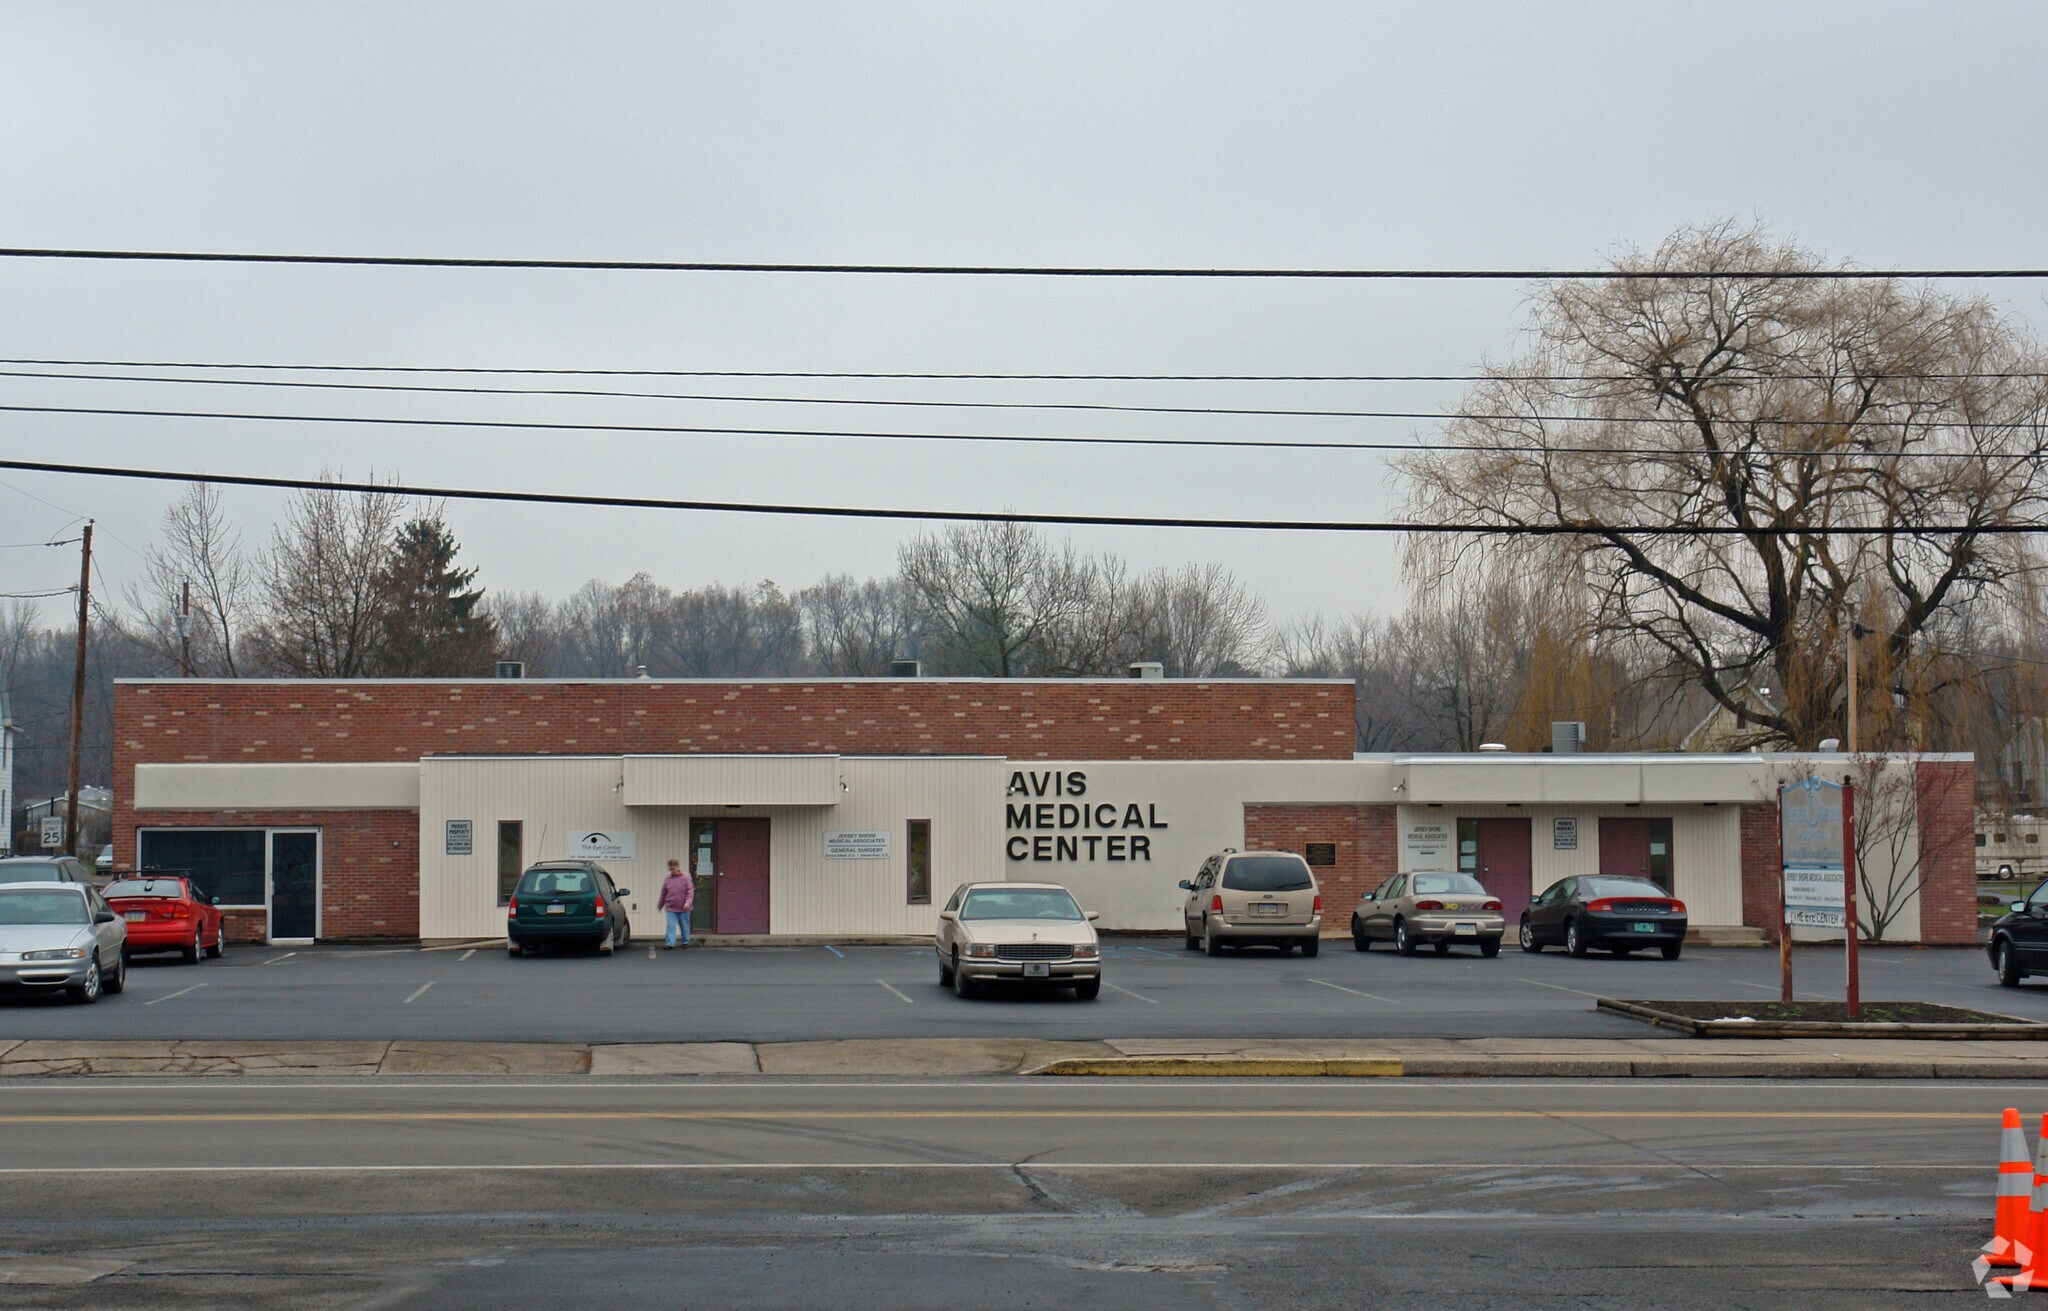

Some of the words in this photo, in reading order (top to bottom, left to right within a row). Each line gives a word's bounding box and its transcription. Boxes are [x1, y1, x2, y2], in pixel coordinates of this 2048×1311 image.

[1006, 771, 1087, 797] AVIS
[1006, 803, 1169, 829] MEDICAL
[43, 832, 60, 844] 25
[1006, 836, 1151, 861] CENTER
[1816, 912, 1839, 924] CENTER
